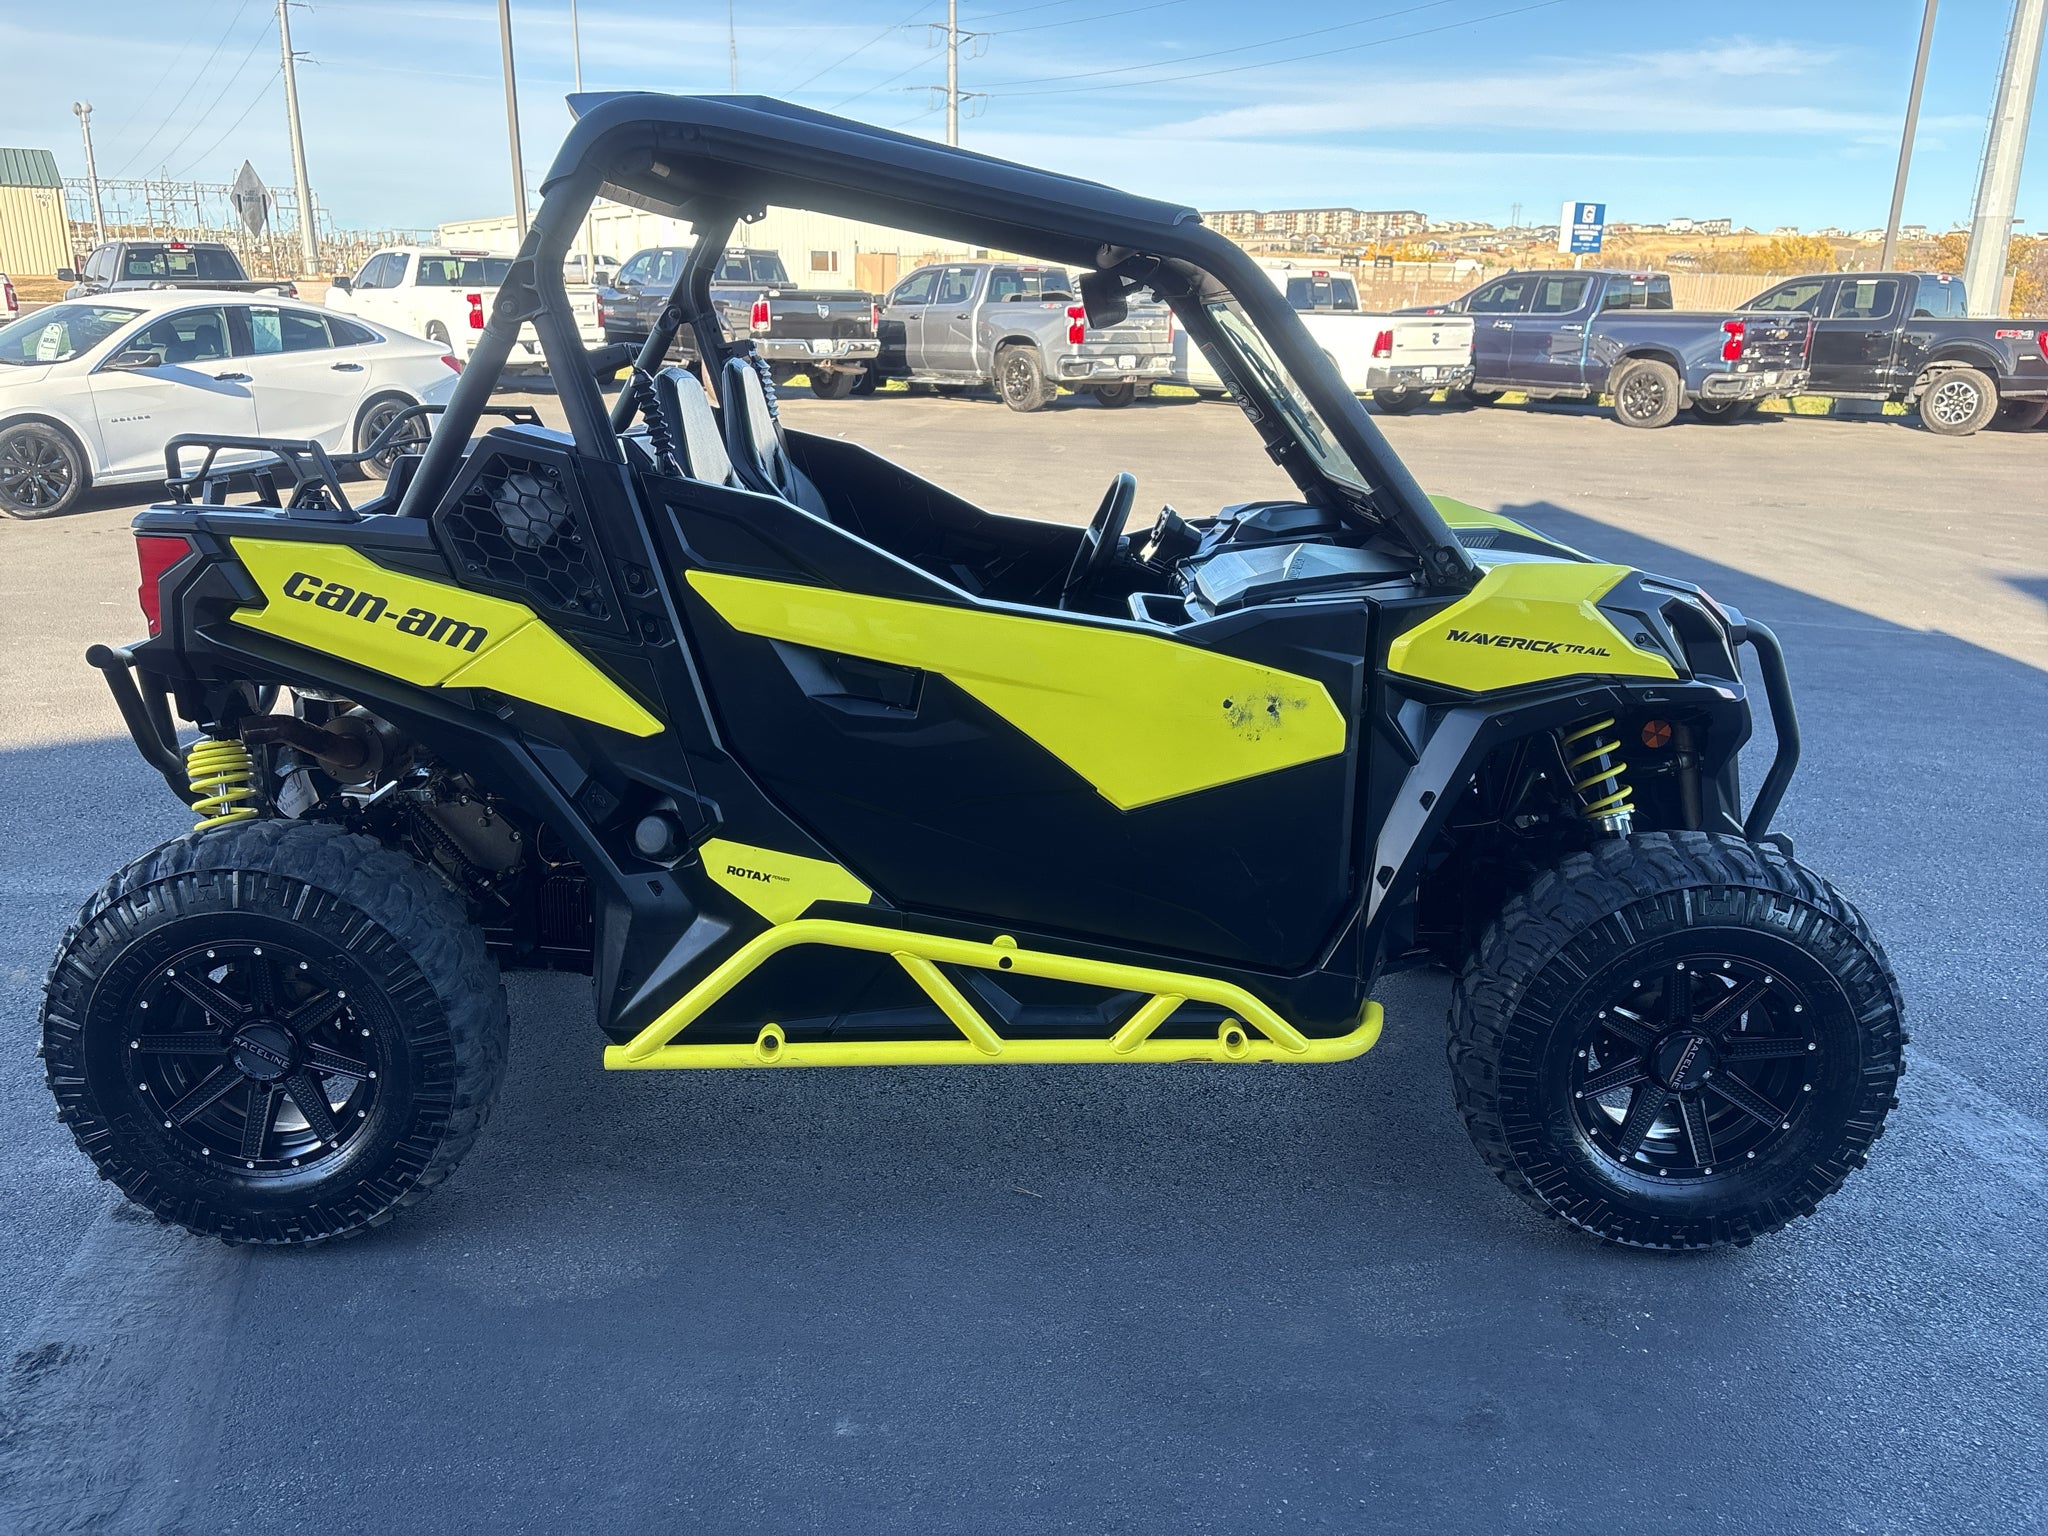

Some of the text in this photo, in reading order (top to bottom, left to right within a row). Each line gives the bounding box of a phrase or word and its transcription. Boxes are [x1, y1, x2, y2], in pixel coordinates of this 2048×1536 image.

[1995, 329, 2034, 340] FX4
[1446, 629, 1611, 657] MAVERICK TRAIL
[726, 865, 773, 884] ROTAX
[232, 1036, 289, 1068] RACELINE
[1671, 1037, 1704, 1089] RACELINE
